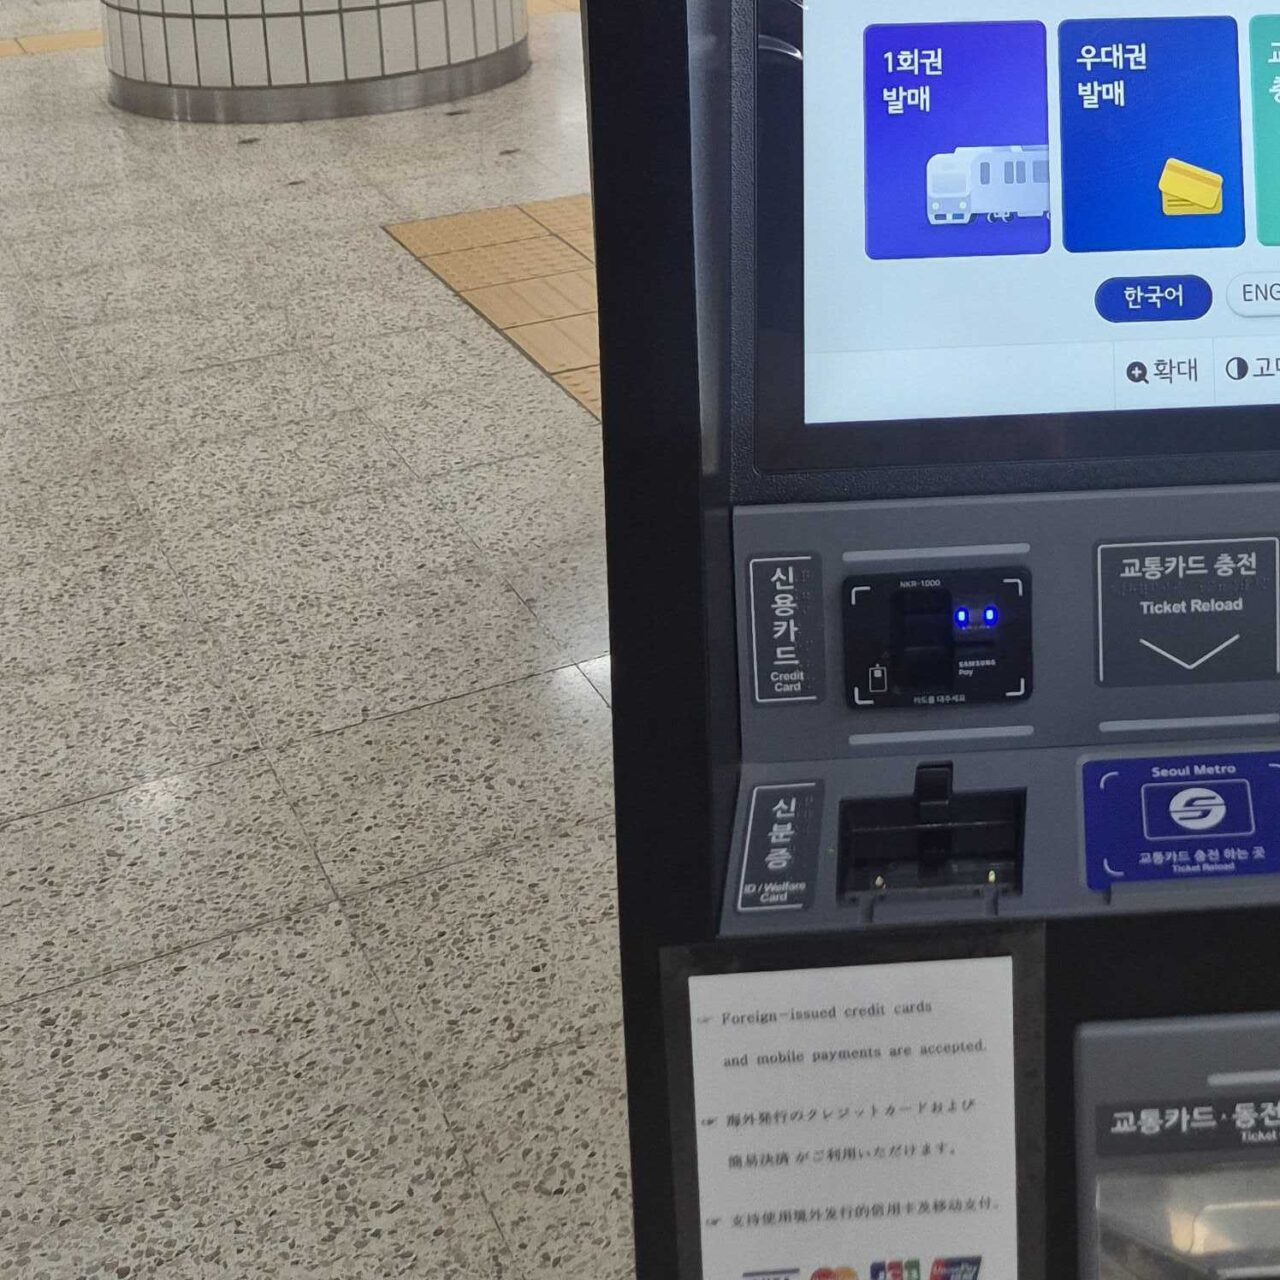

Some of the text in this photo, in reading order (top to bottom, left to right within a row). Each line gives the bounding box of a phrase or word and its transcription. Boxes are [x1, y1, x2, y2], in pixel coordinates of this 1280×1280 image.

[883, 48, 943, 76] 1회권
[1076, 42, 1148, 71] 우대권
[883, 85, 931, 114] 발매
[1077, 80, 1126, 109] 발매
[1124, 283, 1184, 310] 한국어
[1153, 357, 1199, 384] 확대
[1120, 552, 1259, 580] 교통카드 충전
[771, 566, 800, 666] 신용카드
[1140, 598, 1243, 615] Ticket Reload
[770, 671, 804, 682] Credit
[774, 681, 801, 692] Card
[1151, 764, 1237, 778] Seoul Metro
[764, 797, 797, 870] 신분증
[743, 883, 757, 894] ID
[764, 880, 806, 893] Welfare
[760, 892, 788, 903] Card
[721, 1001, 932, 1026] Foreign-issued credit cards
[723, 1039, 987, 1067] and mobile payments are accepted.
[1111, 1106, 1218, 1135] 교통카드
[1241, 1130, 1277, 1144] Ticket
